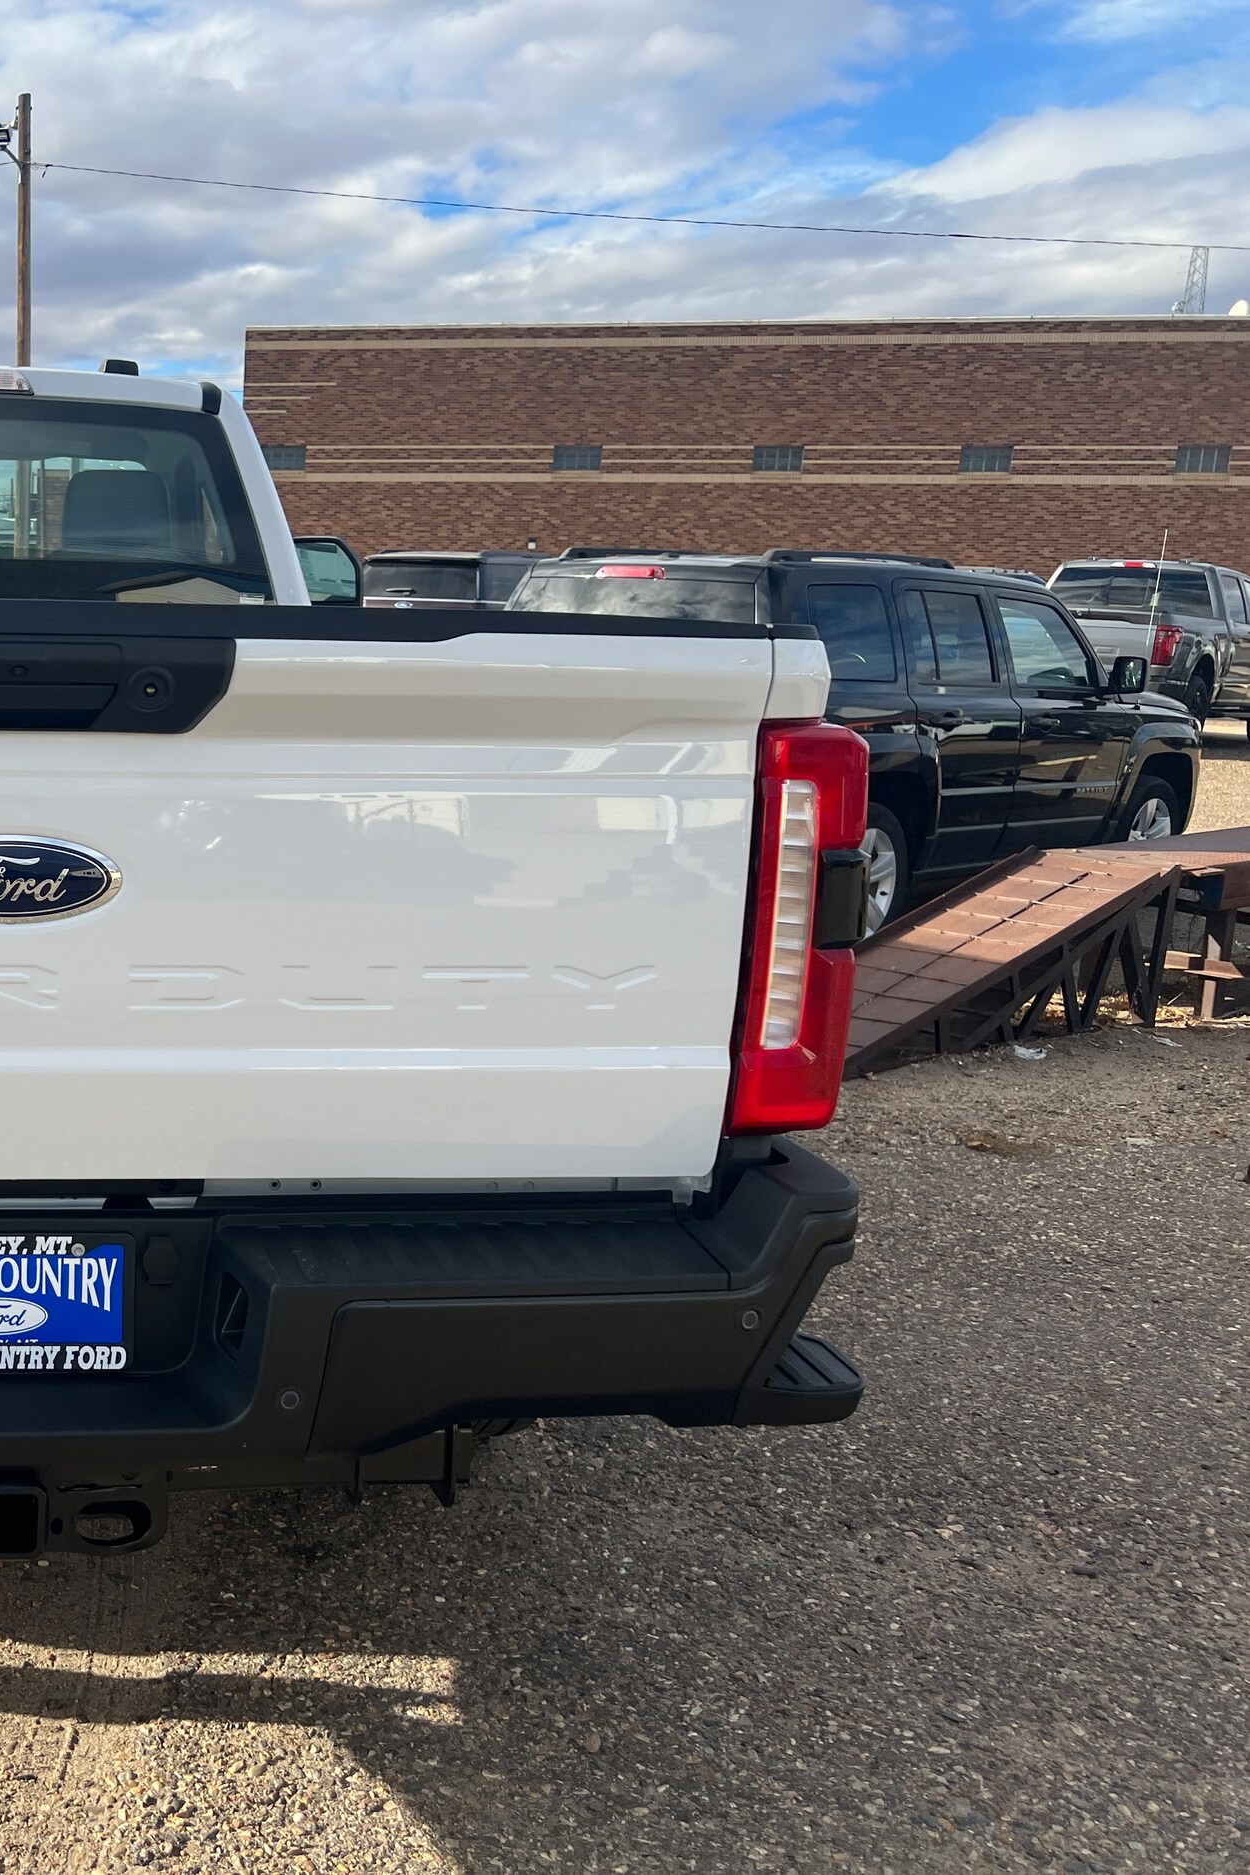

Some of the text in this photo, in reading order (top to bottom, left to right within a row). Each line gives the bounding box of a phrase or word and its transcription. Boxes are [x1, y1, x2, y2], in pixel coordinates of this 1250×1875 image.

[127, 965, 658, 1011] DUTY
[32, 1236, 73, 1255] MT
[63, 1346, 127, 1370] FORD
